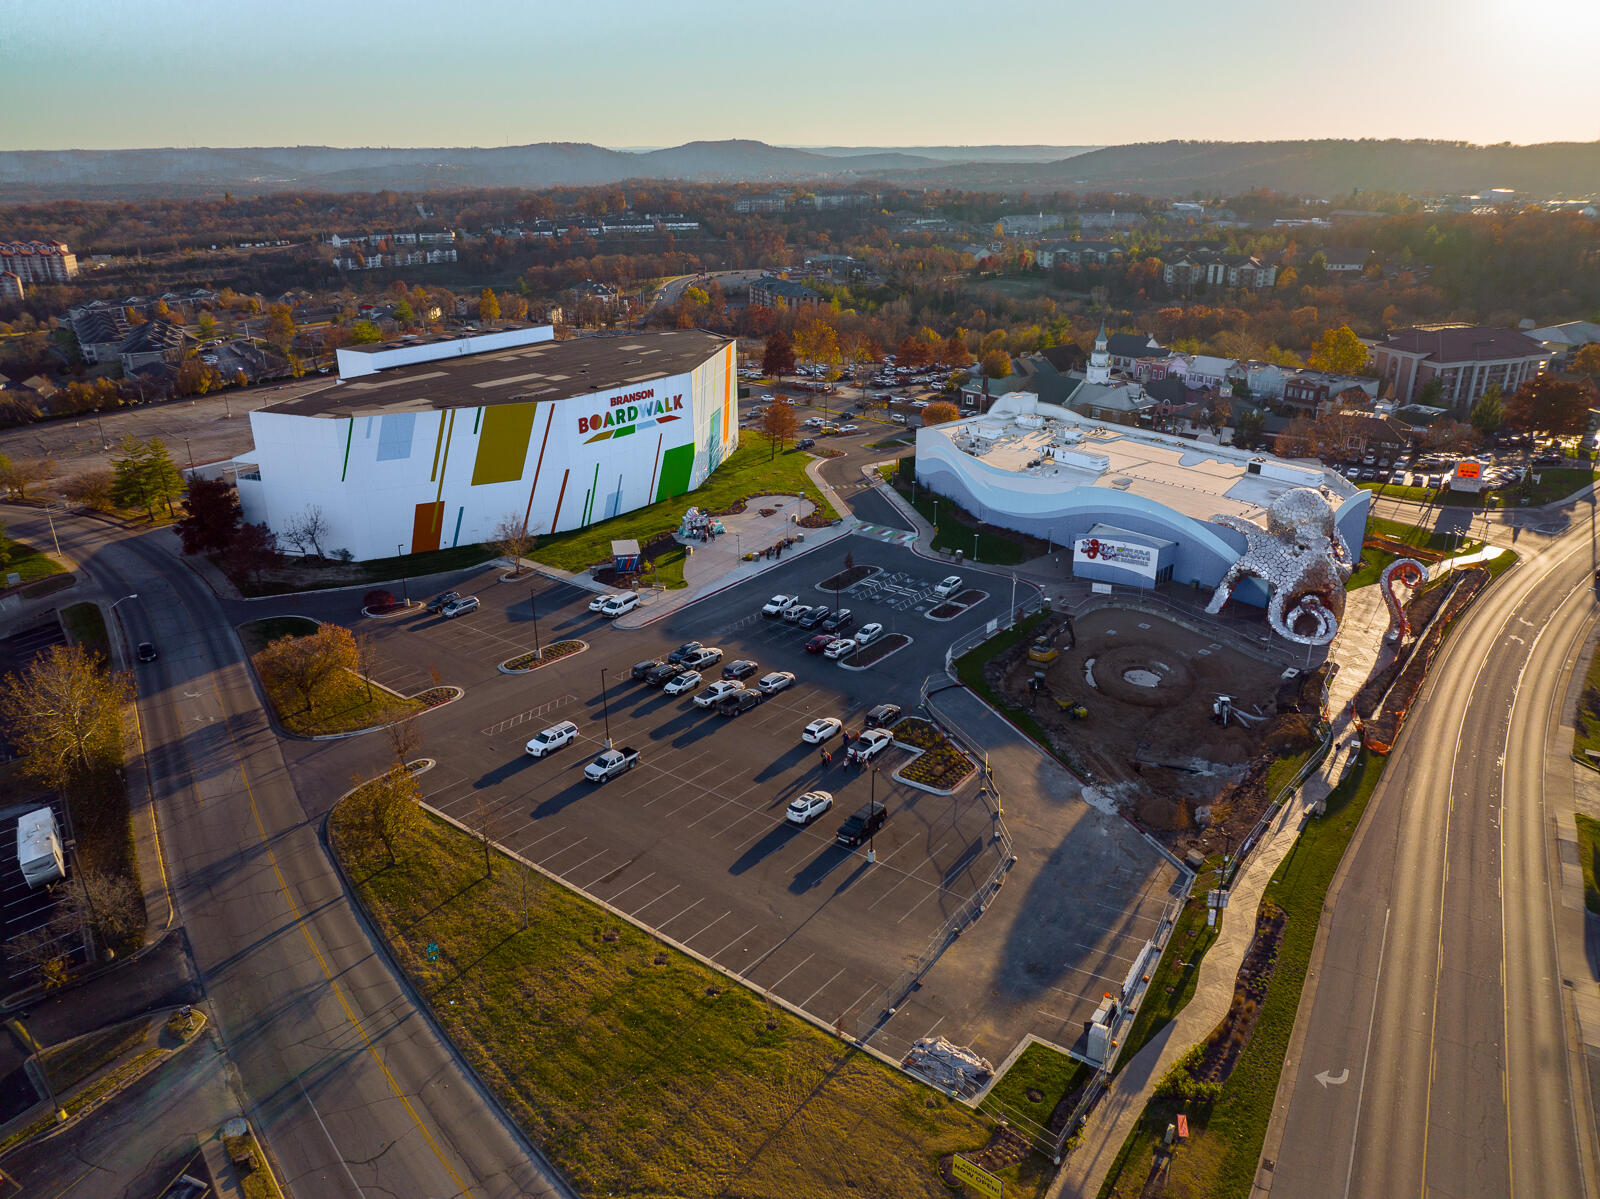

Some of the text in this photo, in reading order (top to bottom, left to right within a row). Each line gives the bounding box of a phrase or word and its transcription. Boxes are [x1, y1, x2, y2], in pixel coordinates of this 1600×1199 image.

[610, 389, 654, 407] BRANSON
[578, 394, 683, 434] BOARDWALK
[954, 1163, 974, 1178] NOW
